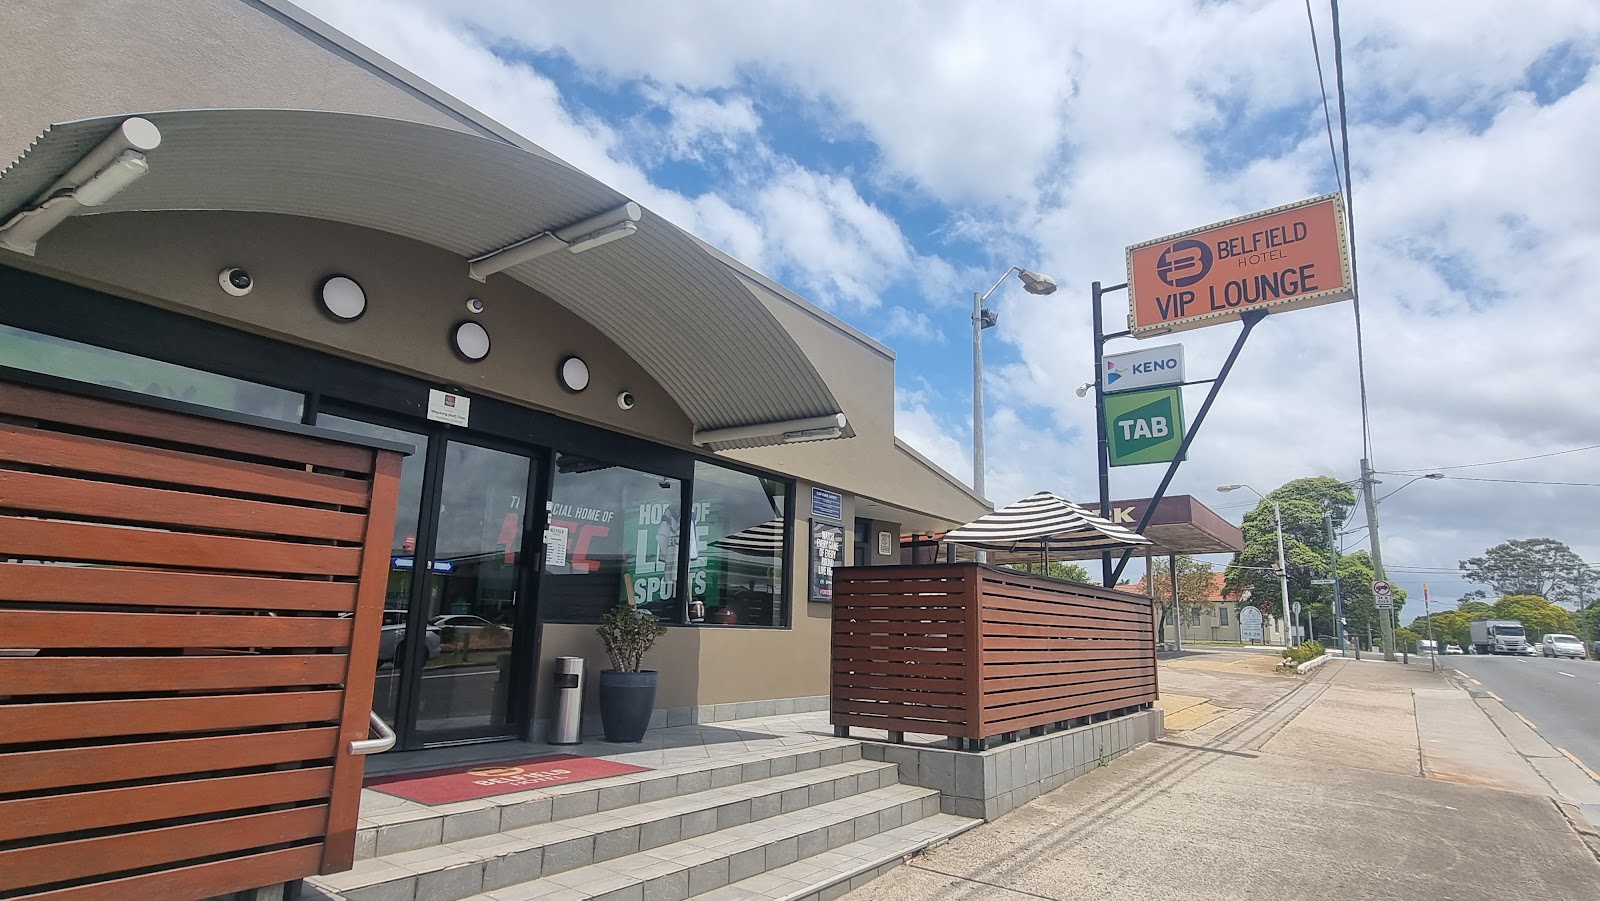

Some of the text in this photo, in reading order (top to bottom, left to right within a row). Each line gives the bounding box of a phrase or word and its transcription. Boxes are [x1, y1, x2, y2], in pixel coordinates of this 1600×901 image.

[1217, 221, 1308, 260] BELFIELD
[1238, 251, 1288, 268] HOTEL
[1156, 264, 1318, 321] VIP LOUNGE
[1132, 357, 1178, 375] KENO
[1118, 416, 1169, 441] TAB
[574, 506, 602, 521] HOME
[601, 511, 615, 523] OF
[825, 548, 837, 559] EVERY
[472, 769, 571, 786] BELFIELD
[509, 776, 568, 786] HOTEL
